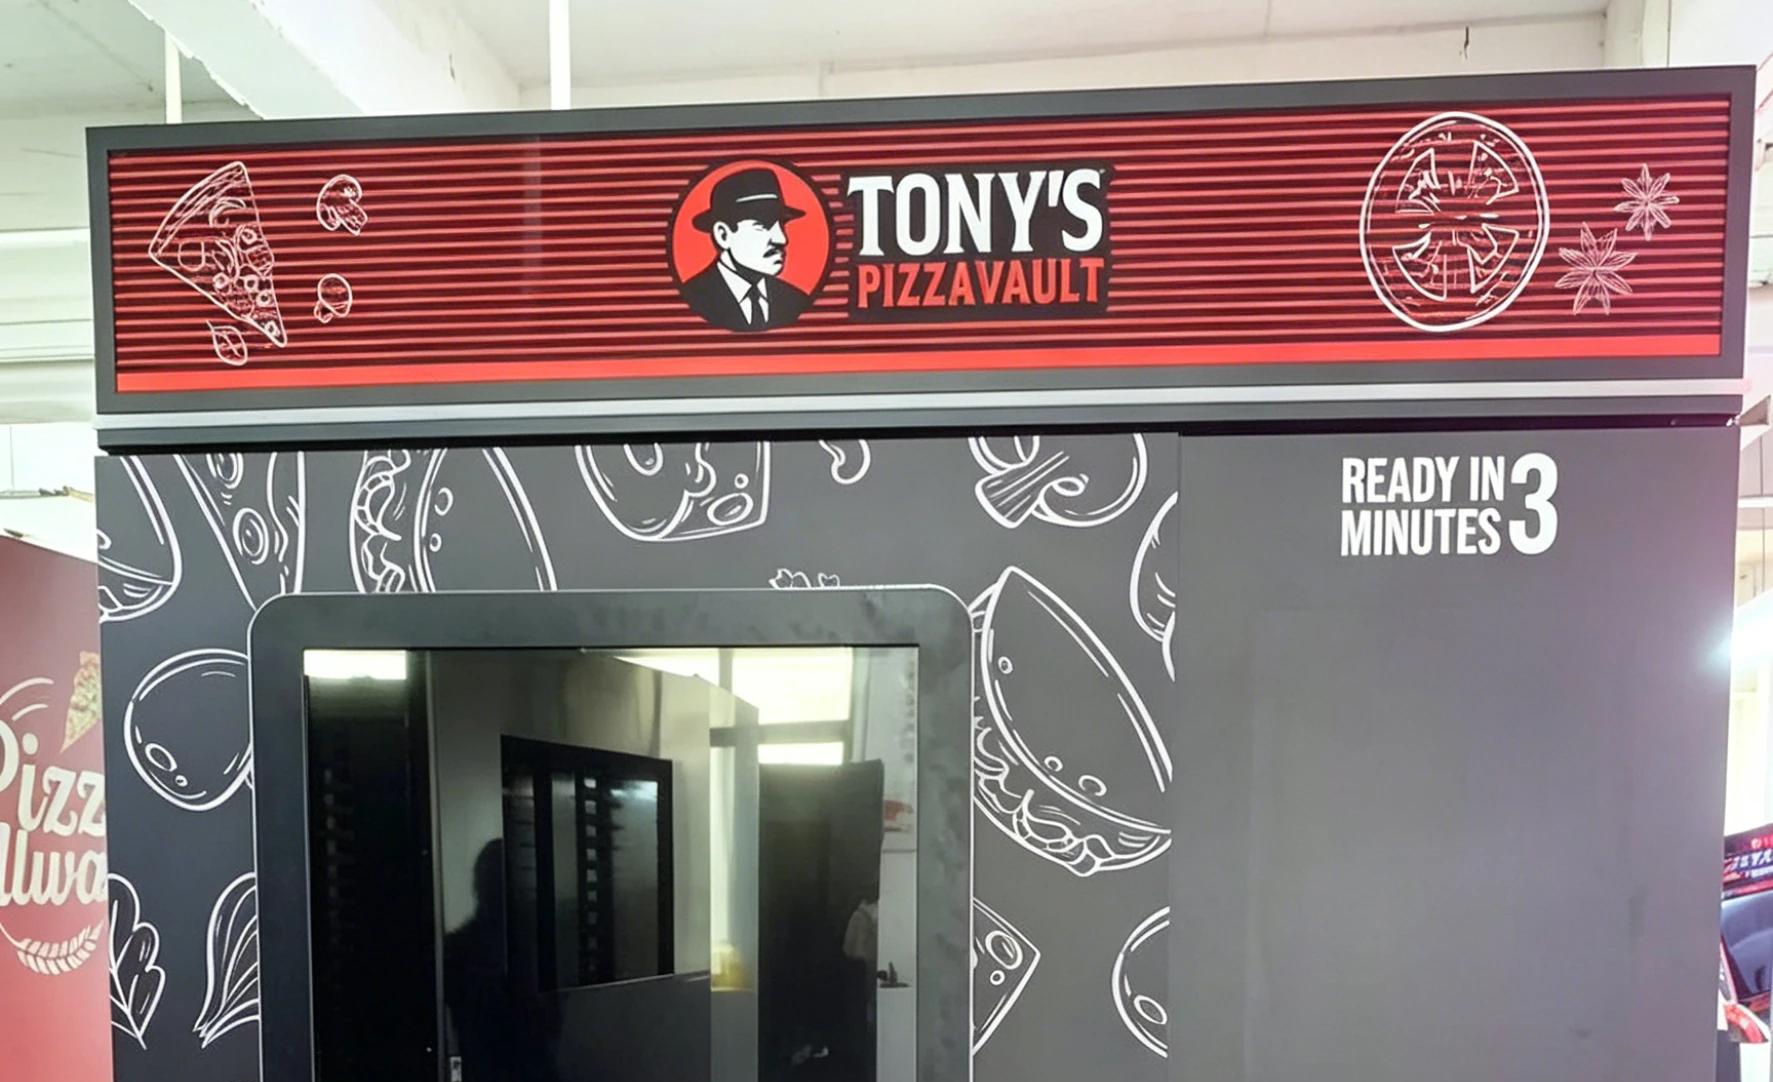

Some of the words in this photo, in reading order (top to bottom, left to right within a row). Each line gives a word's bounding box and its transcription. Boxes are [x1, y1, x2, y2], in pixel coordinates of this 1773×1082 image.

[847, 168, 1103, 256] TONY'S
[857, 257, 1104, 308] PIZZAVAULT
[1342, 456, 1460, 503] READY
[1470, 456, 1505, 501] IN
[1508, 452, 1558, 555] 3
[1341, 507, 1501, 556] MINUTES
